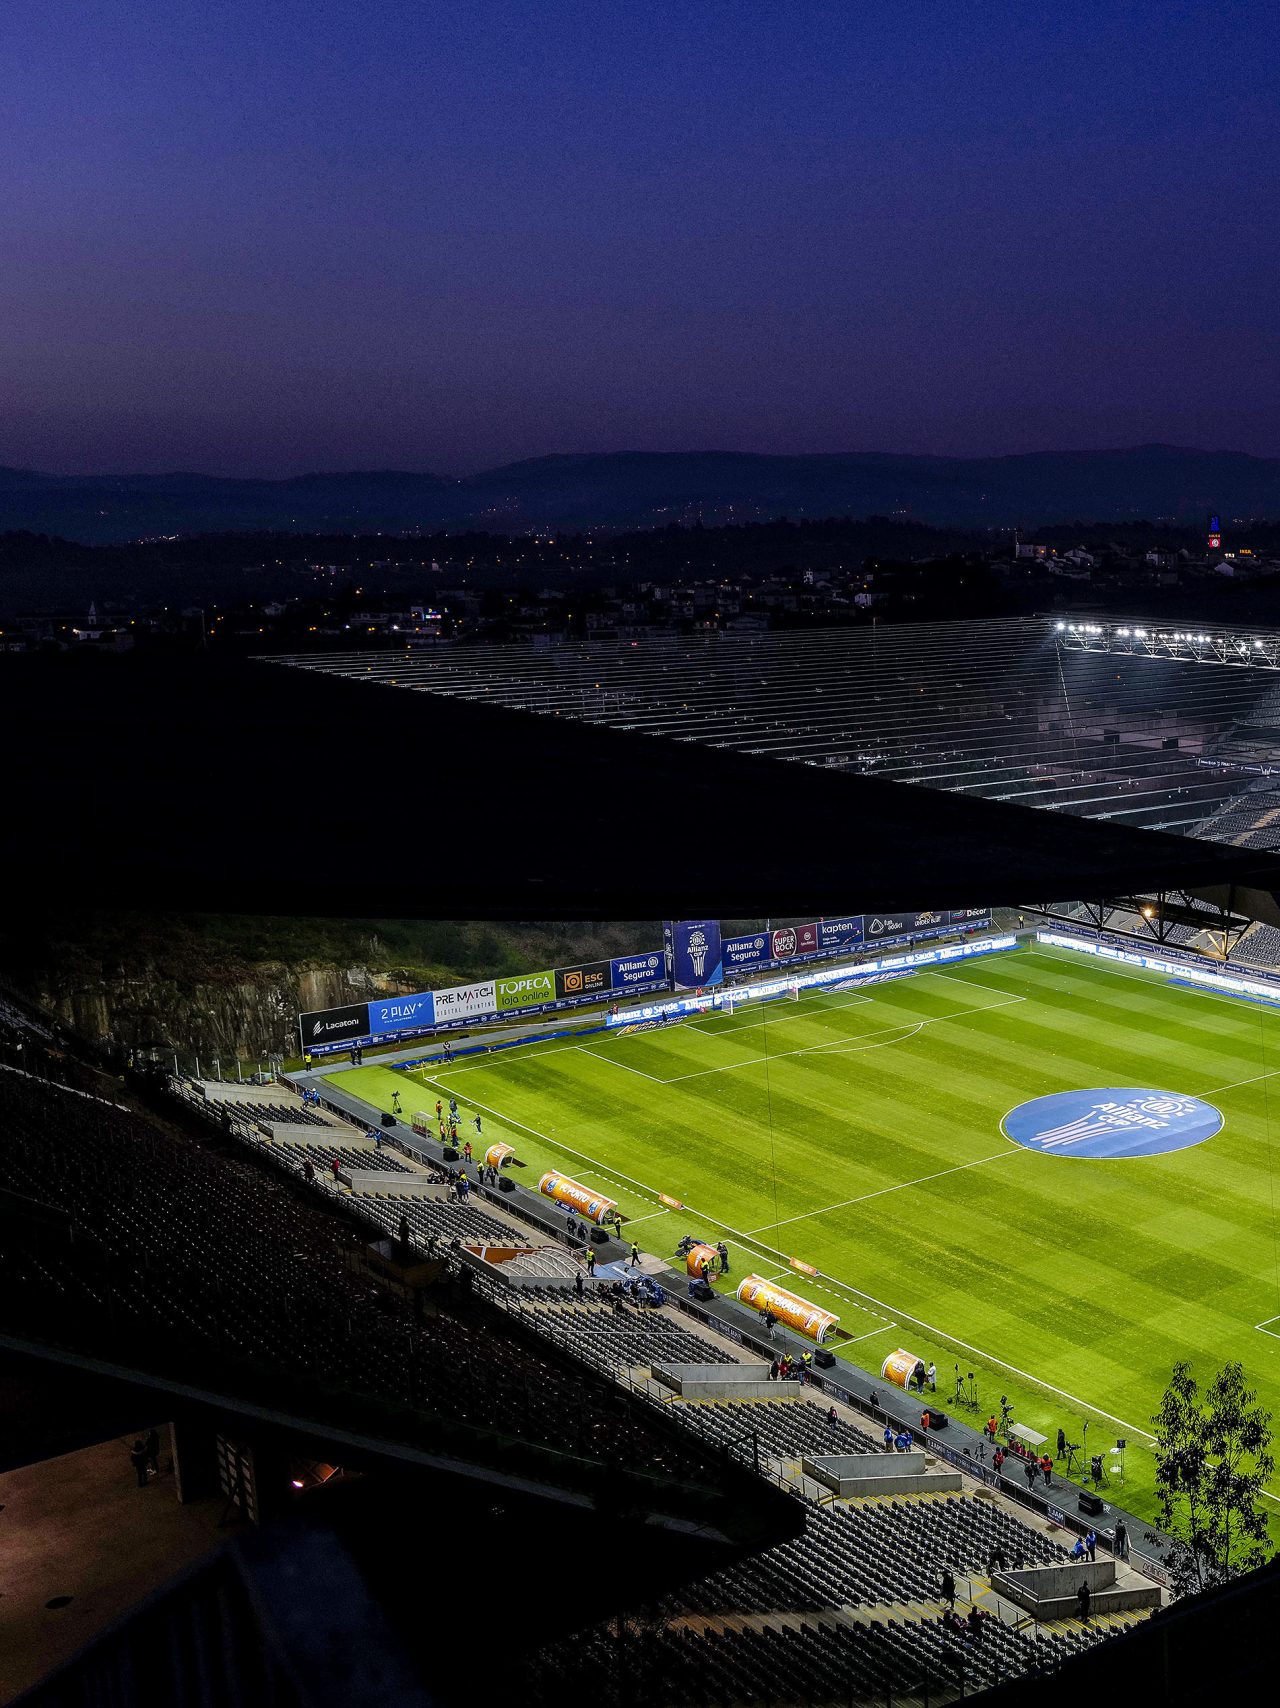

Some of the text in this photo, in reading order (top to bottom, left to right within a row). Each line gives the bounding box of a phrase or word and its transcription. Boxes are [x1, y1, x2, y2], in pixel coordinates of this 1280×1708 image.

[774, 935, 795, 946] SUPER
[687, 945, 709, 954] Allianz
[726, 941, 754, 953] Allianz
[775, 942, 795, 952] BOCK
[731, 950, 761, 962] Seguros
[881, 957, 906, 967] Allianz
[618, 959, 647, 973] Allianz
[584, 972, 604, 983] ESC
[623, 969, 655, 982] Seguros
[498, 975, 552, 995] TOPECA
[584, 981, 604, 989] ONLINE
[435, 986, 494, 1006] PRE MATCH
[502, 989, 550, 1006] loja online
[381, 1008, 389, 1020] 2
[436, 1007, 462, 1017] DIGITAL
[611, 1009, 642, 1022] Allianz
[326, 1018, 359, 1030] Lacatoni
[1090, 1102, 1171, 1129] Allianz
[1097, 1114, 1132, 1126] CUP
[567, 1186, 591, 1202] PORTO
[773, 1295, 804, 1316] BRAGA
